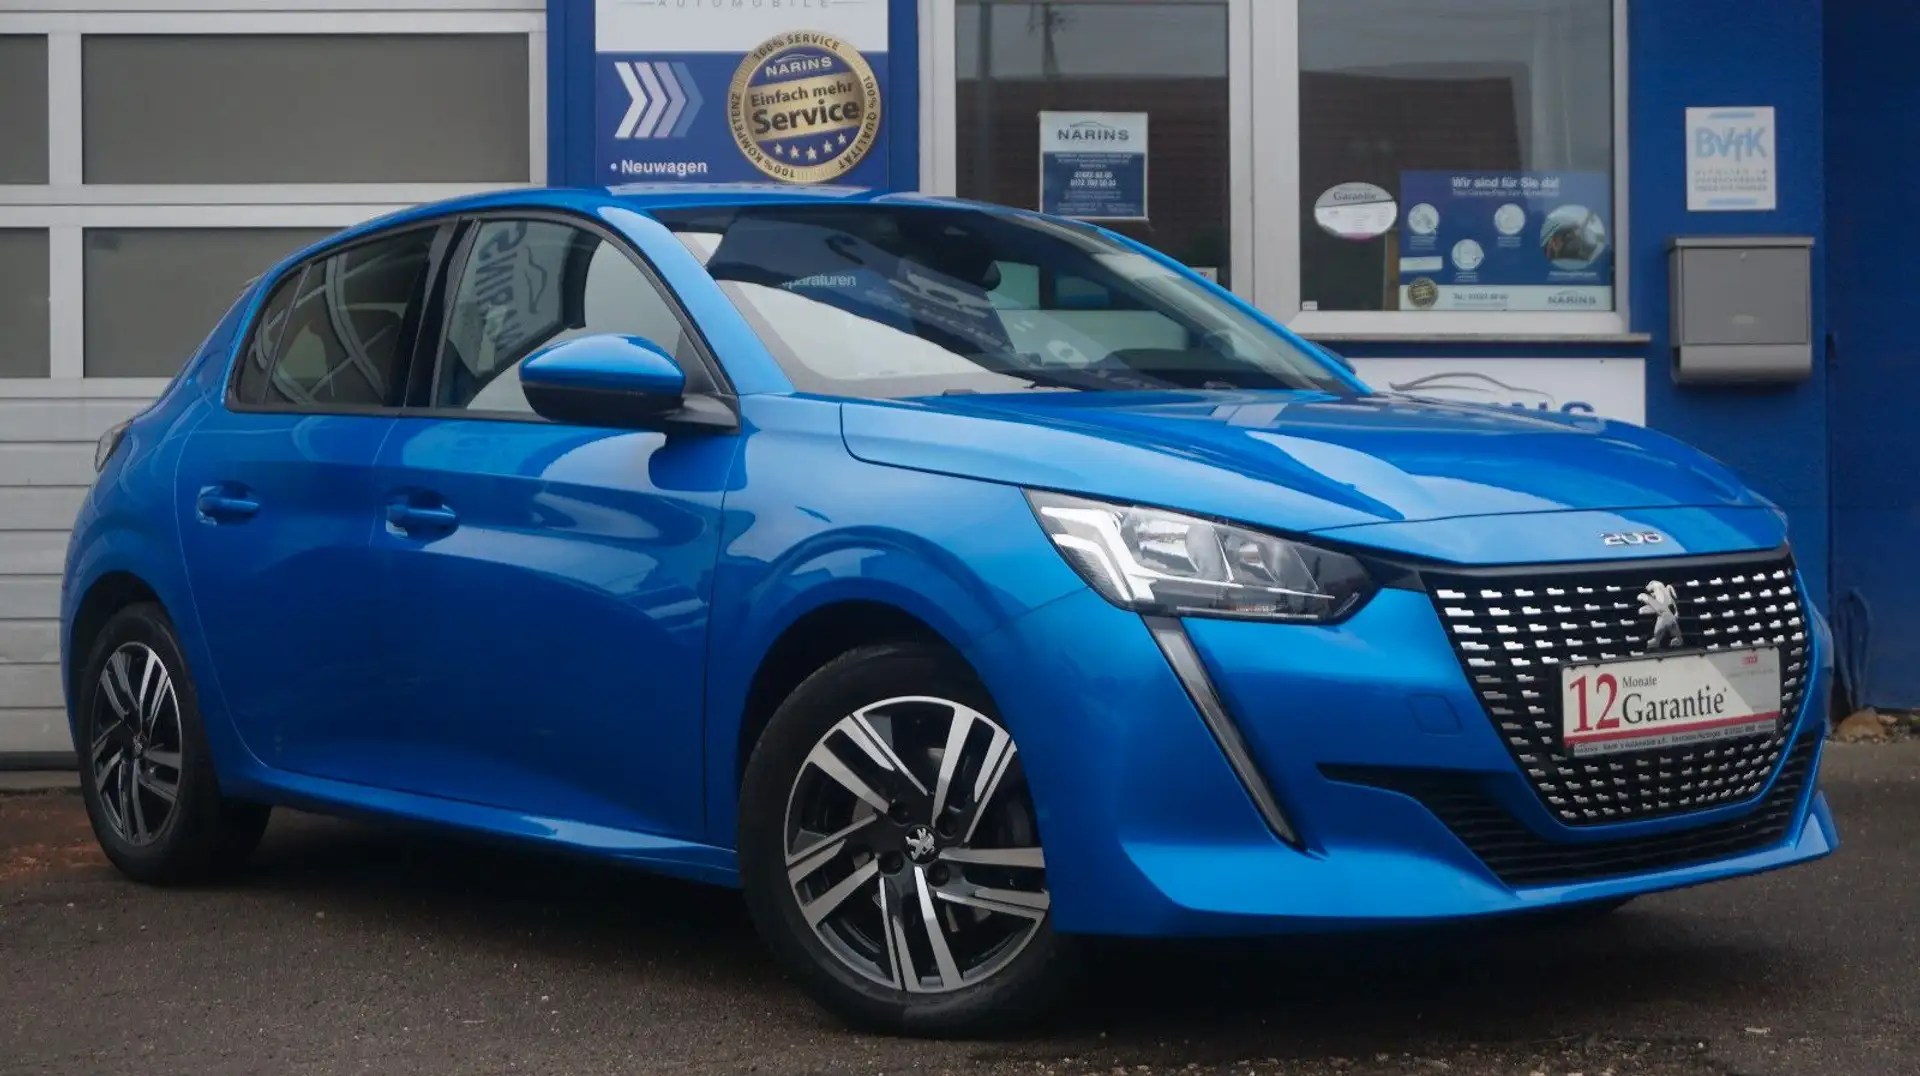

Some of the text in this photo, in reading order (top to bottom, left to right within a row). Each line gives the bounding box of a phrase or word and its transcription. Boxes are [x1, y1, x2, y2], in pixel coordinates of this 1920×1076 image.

[753, 33, 840, 61] 100% SERVICE
[765, 56, 832, 77] NARINS
[751, 80, 854, 107] Einfach mehr
[864, 75, 878, 109] 100%
[752, 99, 860, 134] Service
[731, 92, 795, 178] 100% KOMPETENZ
[1057, 129, 1130, 141] NARINS
[621, 159, 707, 177] Neuwagen
[1452, 176, 1471, 188] Wir
[1474, 176, 1498, 188] sind
[1502, 176, 1517, 188] für
[1521, 176, 1538, 188] Sie
[1547, 295, 1597, 305] NARINS
[1569, 672, 1658, 733] 12 Monate
